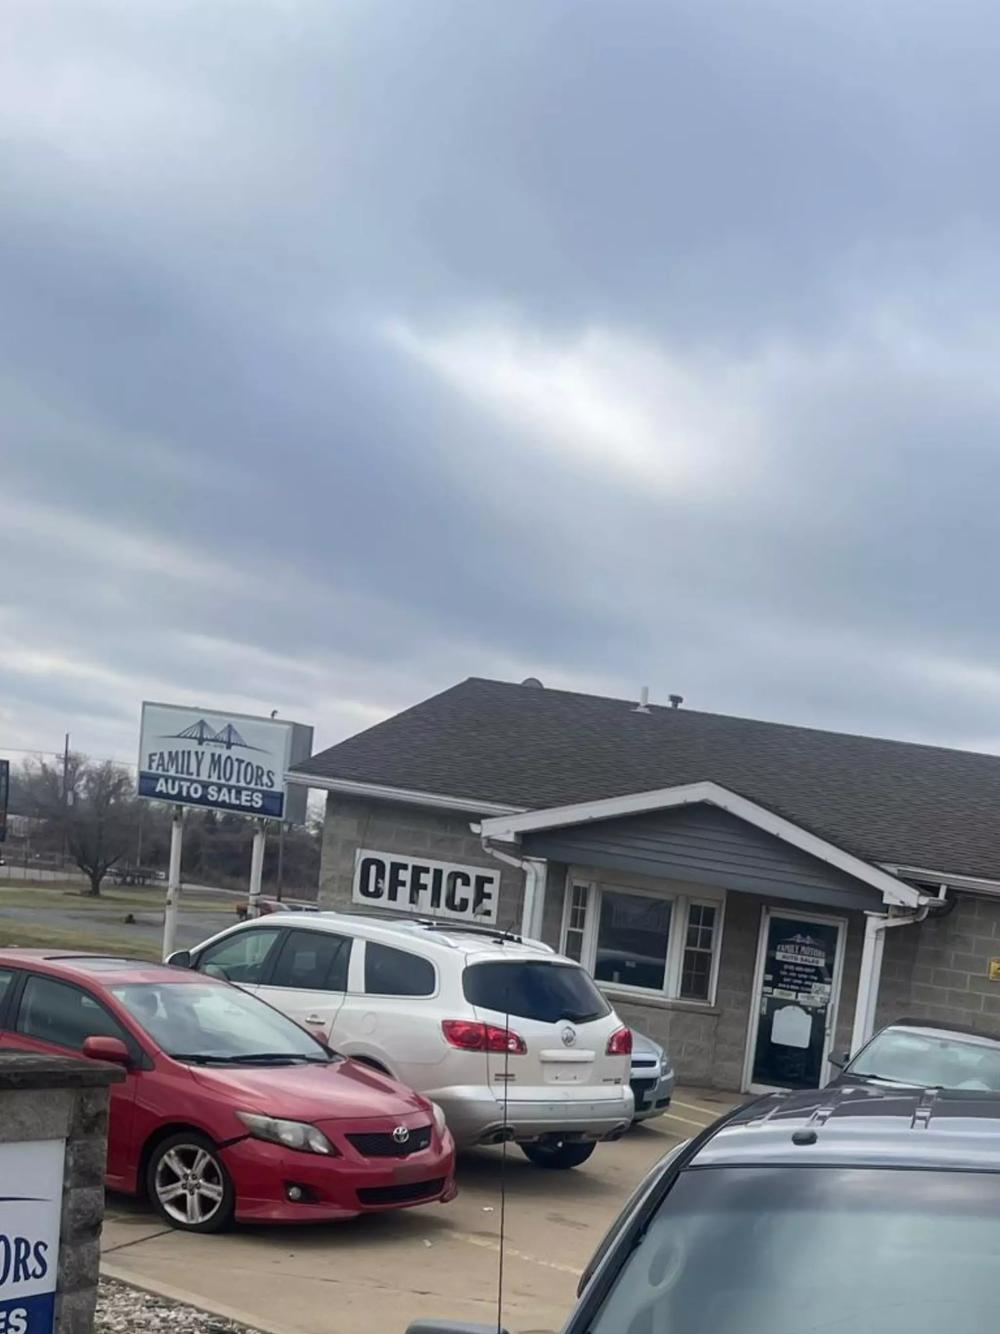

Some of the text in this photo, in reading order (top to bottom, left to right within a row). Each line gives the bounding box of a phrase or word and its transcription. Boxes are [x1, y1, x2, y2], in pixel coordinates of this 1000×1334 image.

[147, 749, 275, 789] FAMILY MOTORS
[155, 777, 263, 808] AUTO SALES
[359, 857, 494, 917] OFFICE
